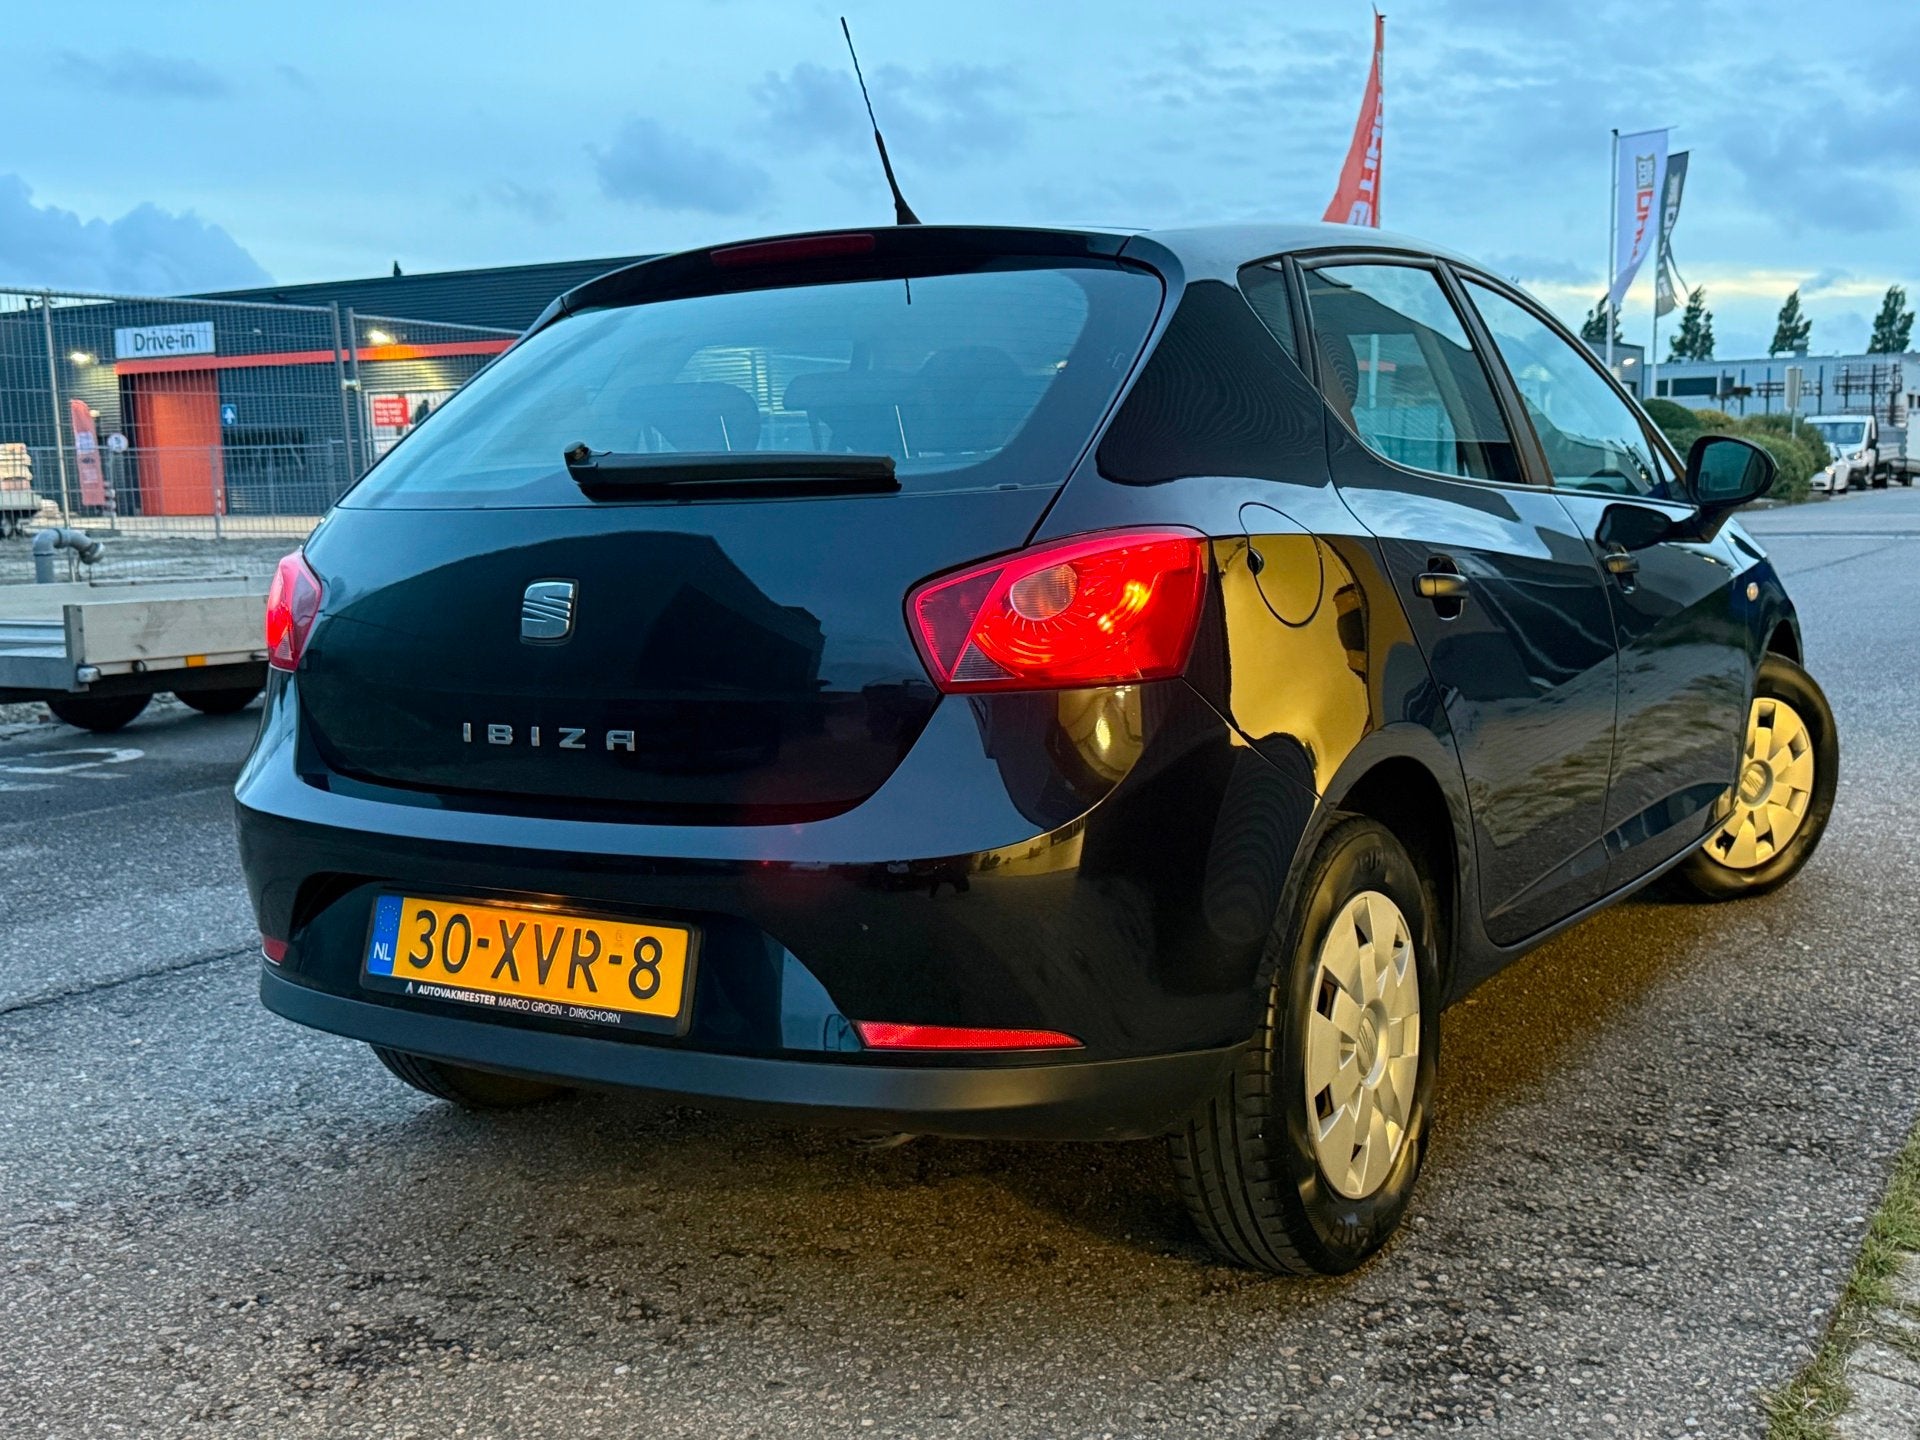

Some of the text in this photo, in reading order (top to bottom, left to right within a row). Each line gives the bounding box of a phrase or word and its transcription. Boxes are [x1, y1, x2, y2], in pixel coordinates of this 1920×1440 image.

[134, 329, 196, 352] Drive-in
[462, 722, 636, 752] IBIZA
[373, 941, 392, 962] NL
[408, 908, 664, 1000] 30-XVR-8
[417, 984, 496, 1006] AUTOVAKMEESTER
[497, 996, 530, 1011] MARCO
[531, 1001, 563, 1016] GROEN
[568, 1006, 621, 1024] DIRKSHORN
